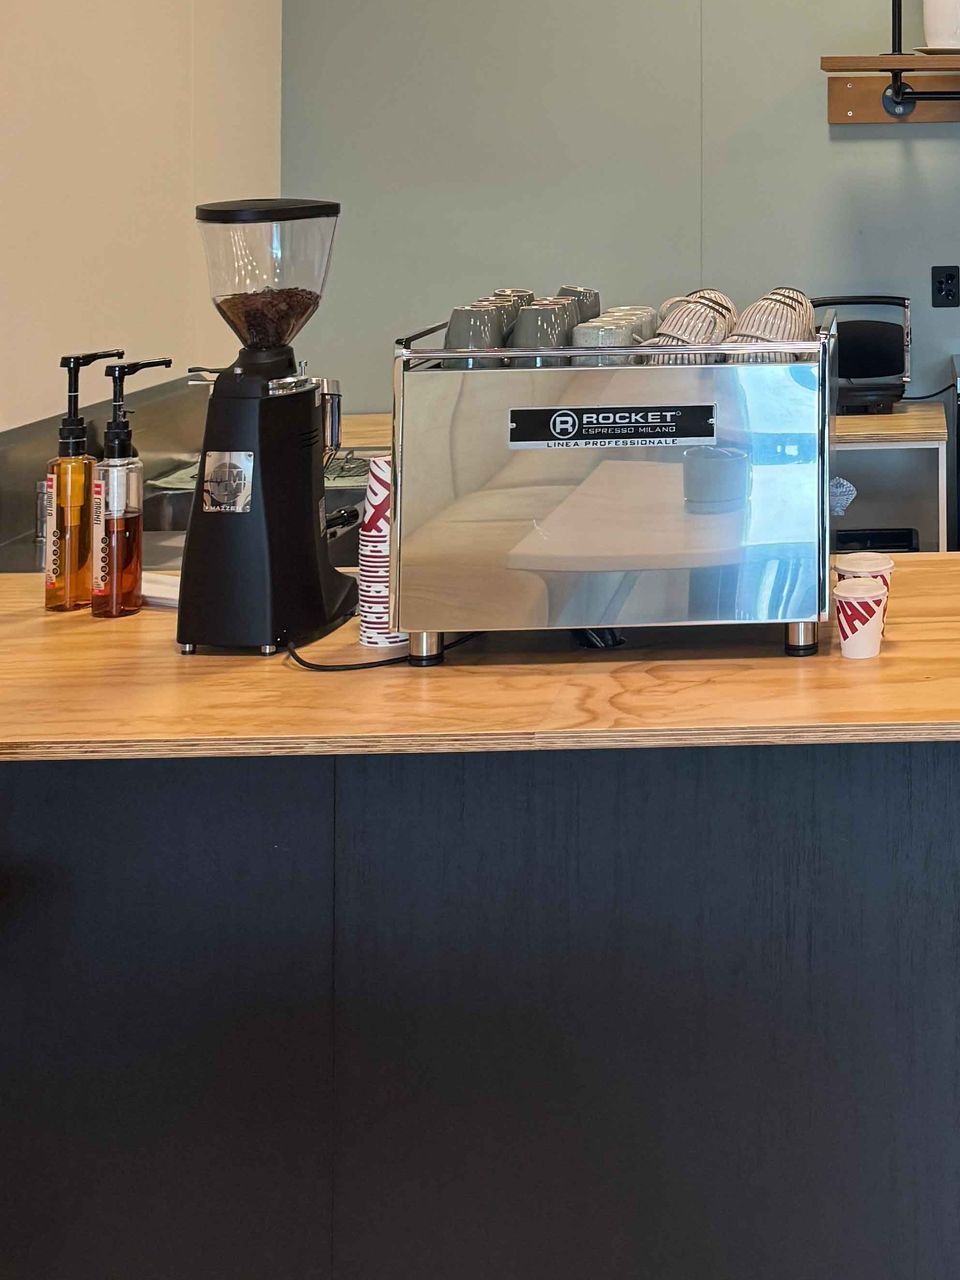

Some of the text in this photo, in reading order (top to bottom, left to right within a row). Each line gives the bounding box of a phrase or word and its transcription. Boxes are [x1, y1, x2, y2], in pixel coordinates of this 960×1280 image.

[582, 411, 676, 424] ROCKET
[582, 427, 635, 435] ESPRESSO
[584, 438, 678, 447] PROFESSIONALE
